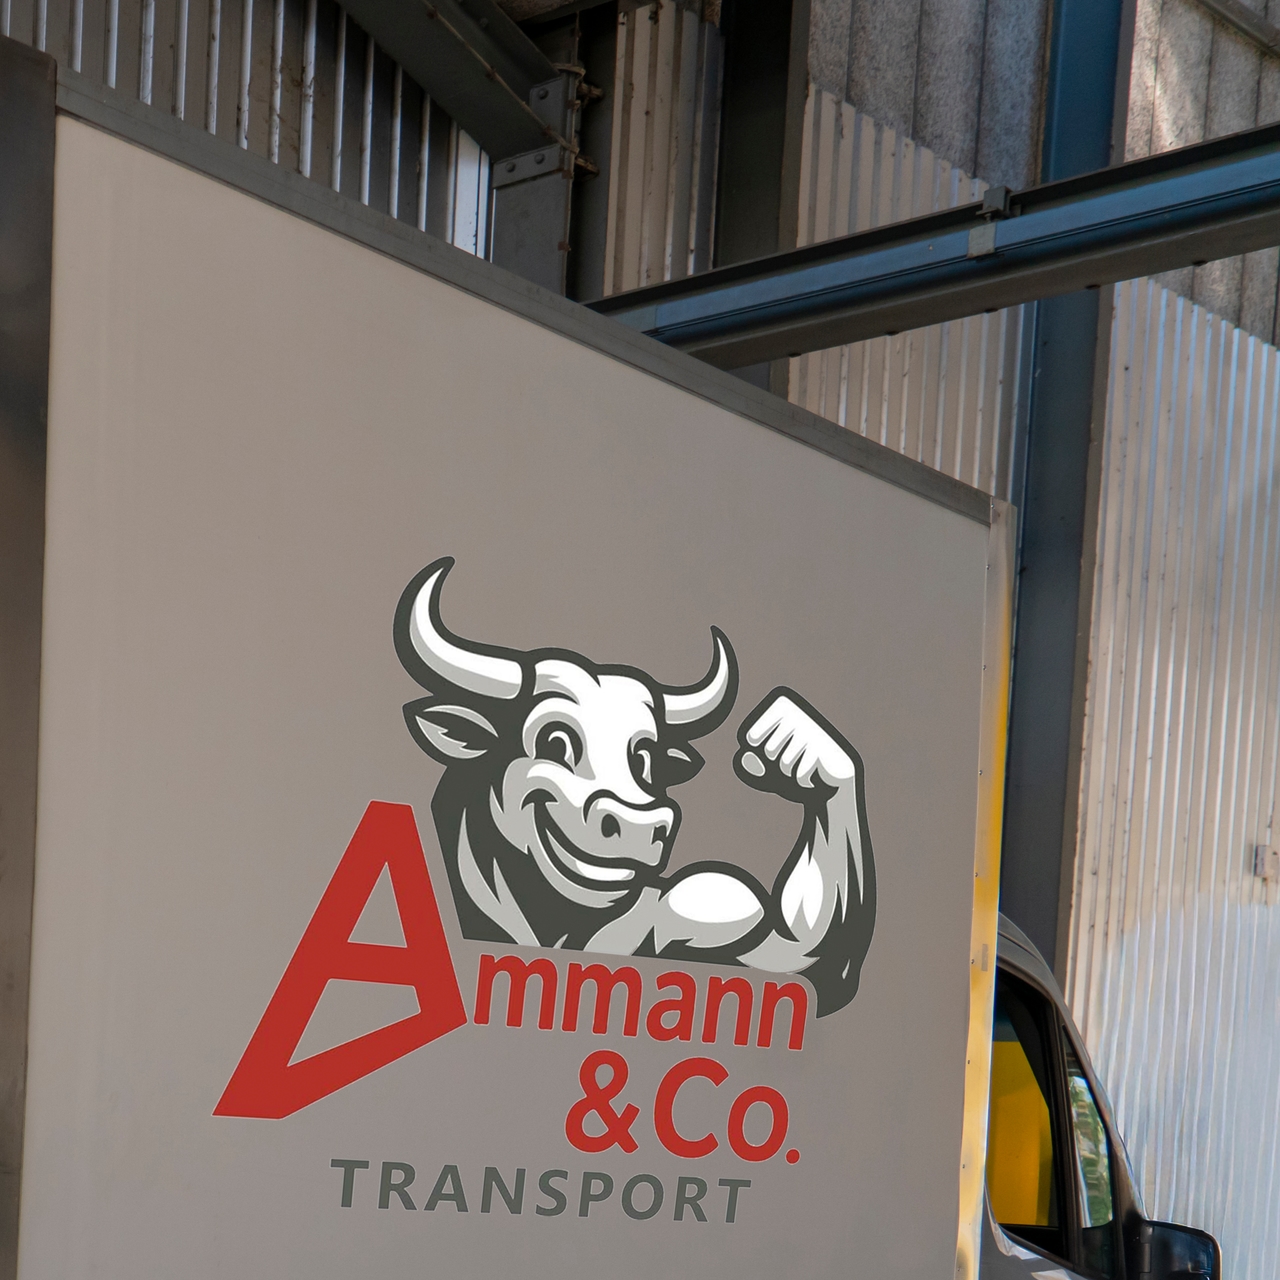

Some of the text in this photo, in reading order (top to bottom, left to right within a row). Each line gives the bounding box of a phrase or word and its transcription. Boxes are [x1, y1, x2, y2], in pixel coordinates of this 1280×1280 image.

[211, 800, 808, 1120] Ammann
[564, 1049, 800, 1165] &Co.
[330, 1158, 752, 1224] TRANSPORT
